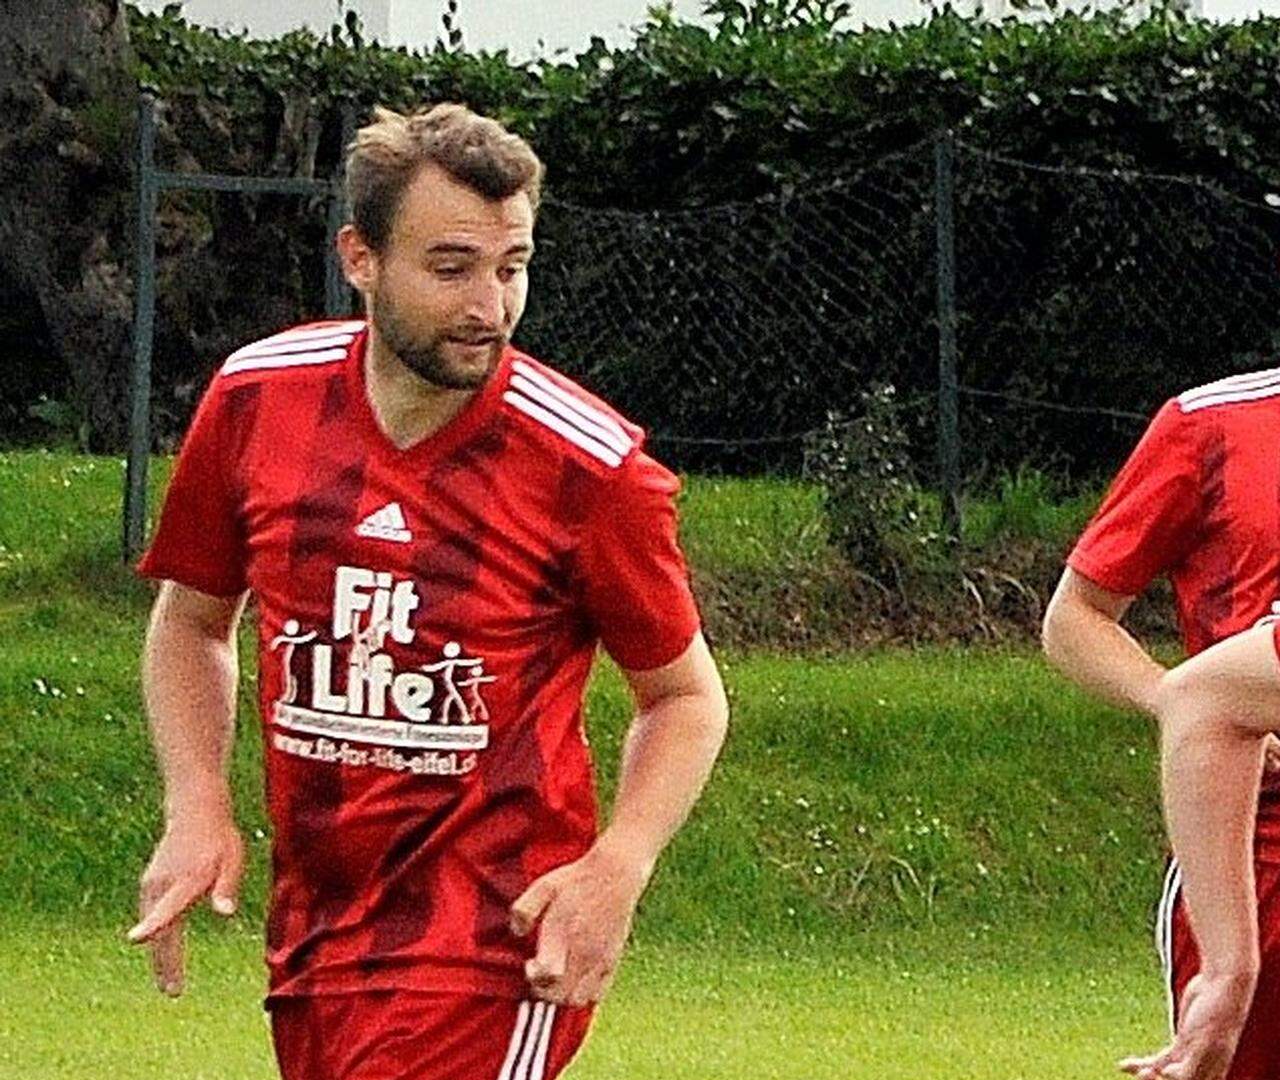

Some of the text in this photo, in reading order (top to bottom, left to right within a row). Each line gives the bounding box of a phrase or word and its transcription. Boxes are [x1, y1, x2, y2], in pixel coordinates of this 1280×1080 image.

[333, 566, 420, 644] Fit
[313, 645, 434, 722] Life
[273, 732, 478, 776] www.fit-for-life-eifel.d
